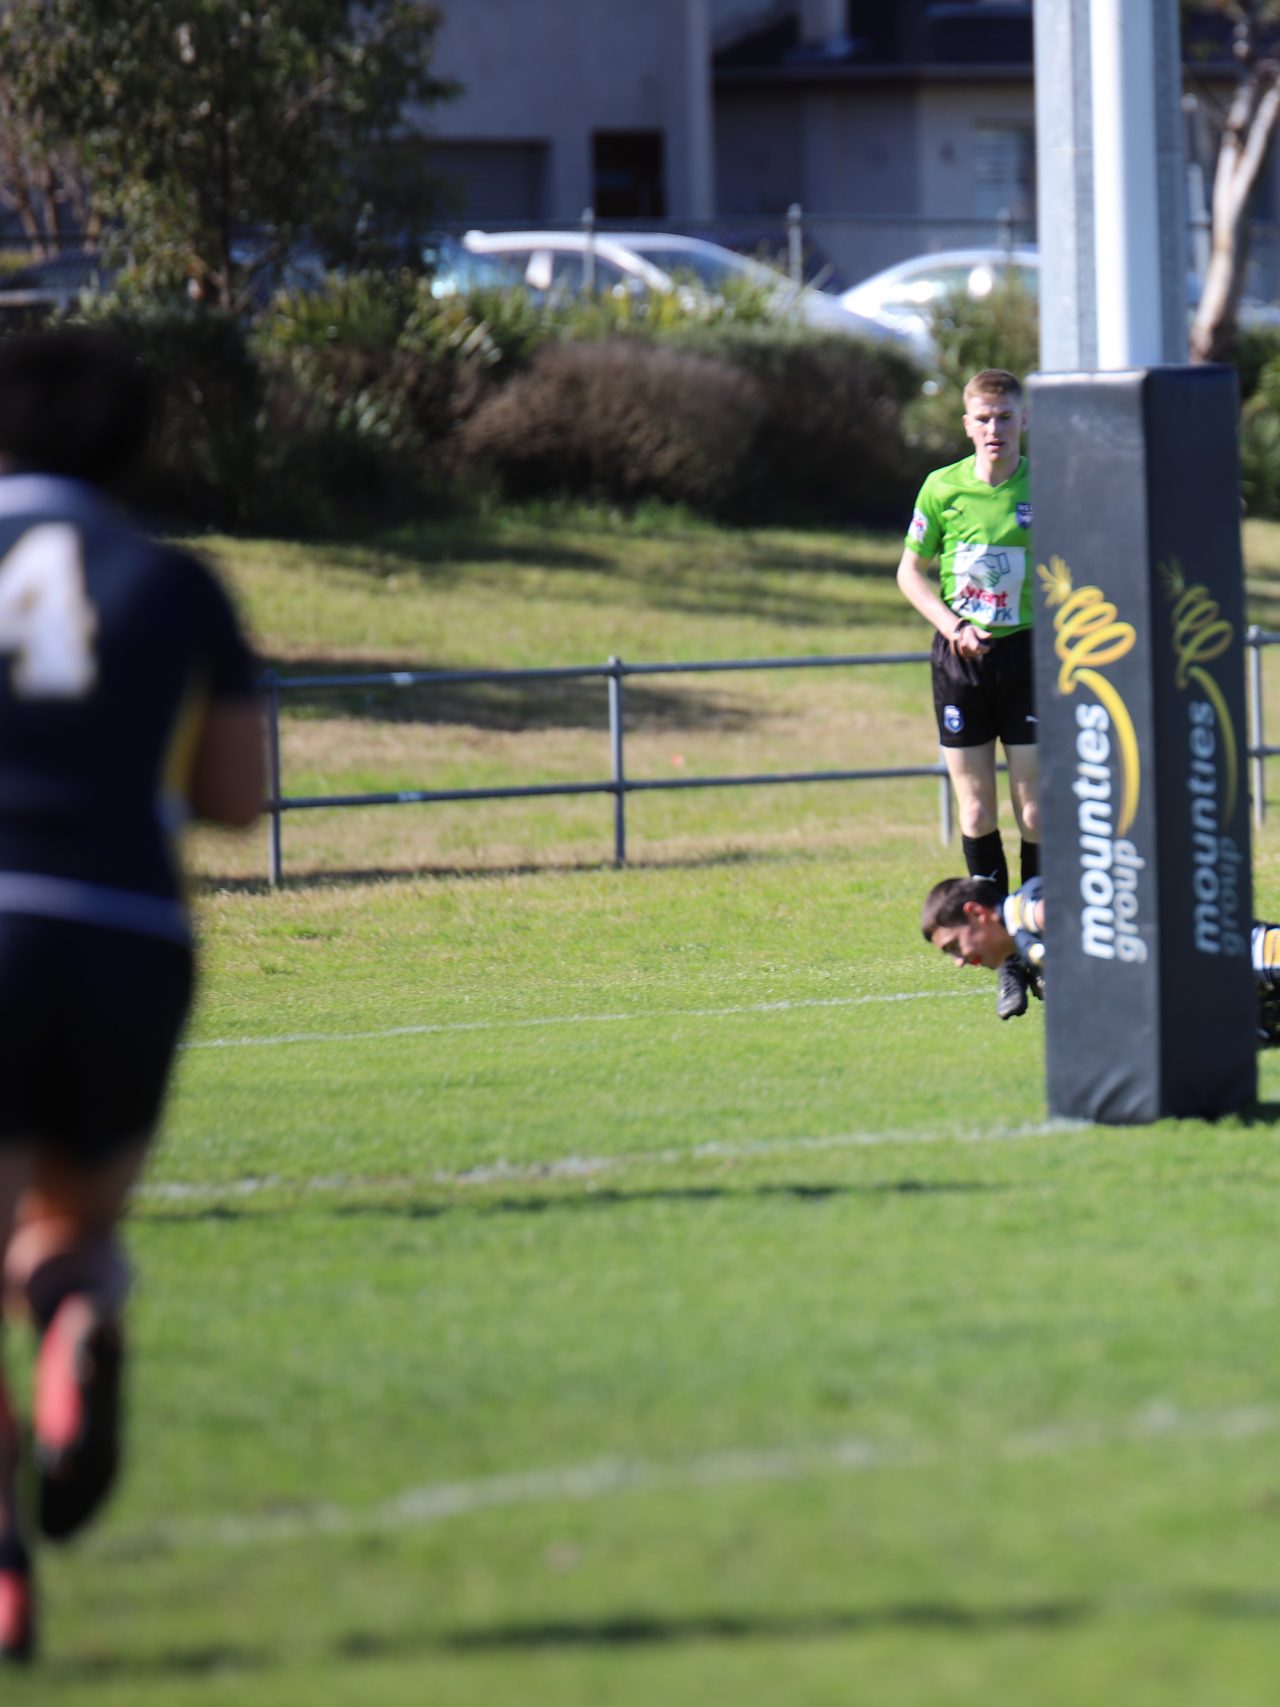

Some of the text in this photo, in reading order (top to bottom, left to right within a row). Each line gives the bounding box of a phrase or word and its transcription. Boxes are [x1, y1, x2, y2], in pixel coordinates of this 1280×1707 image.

[0, 521, 99, 699] 4
[1072, 703, 1114, 961] mounties
[1113, 838, 1148, 964] group
[1187, 702, 1220, 956] mounties
[1220, 836, 1247, 957] group
